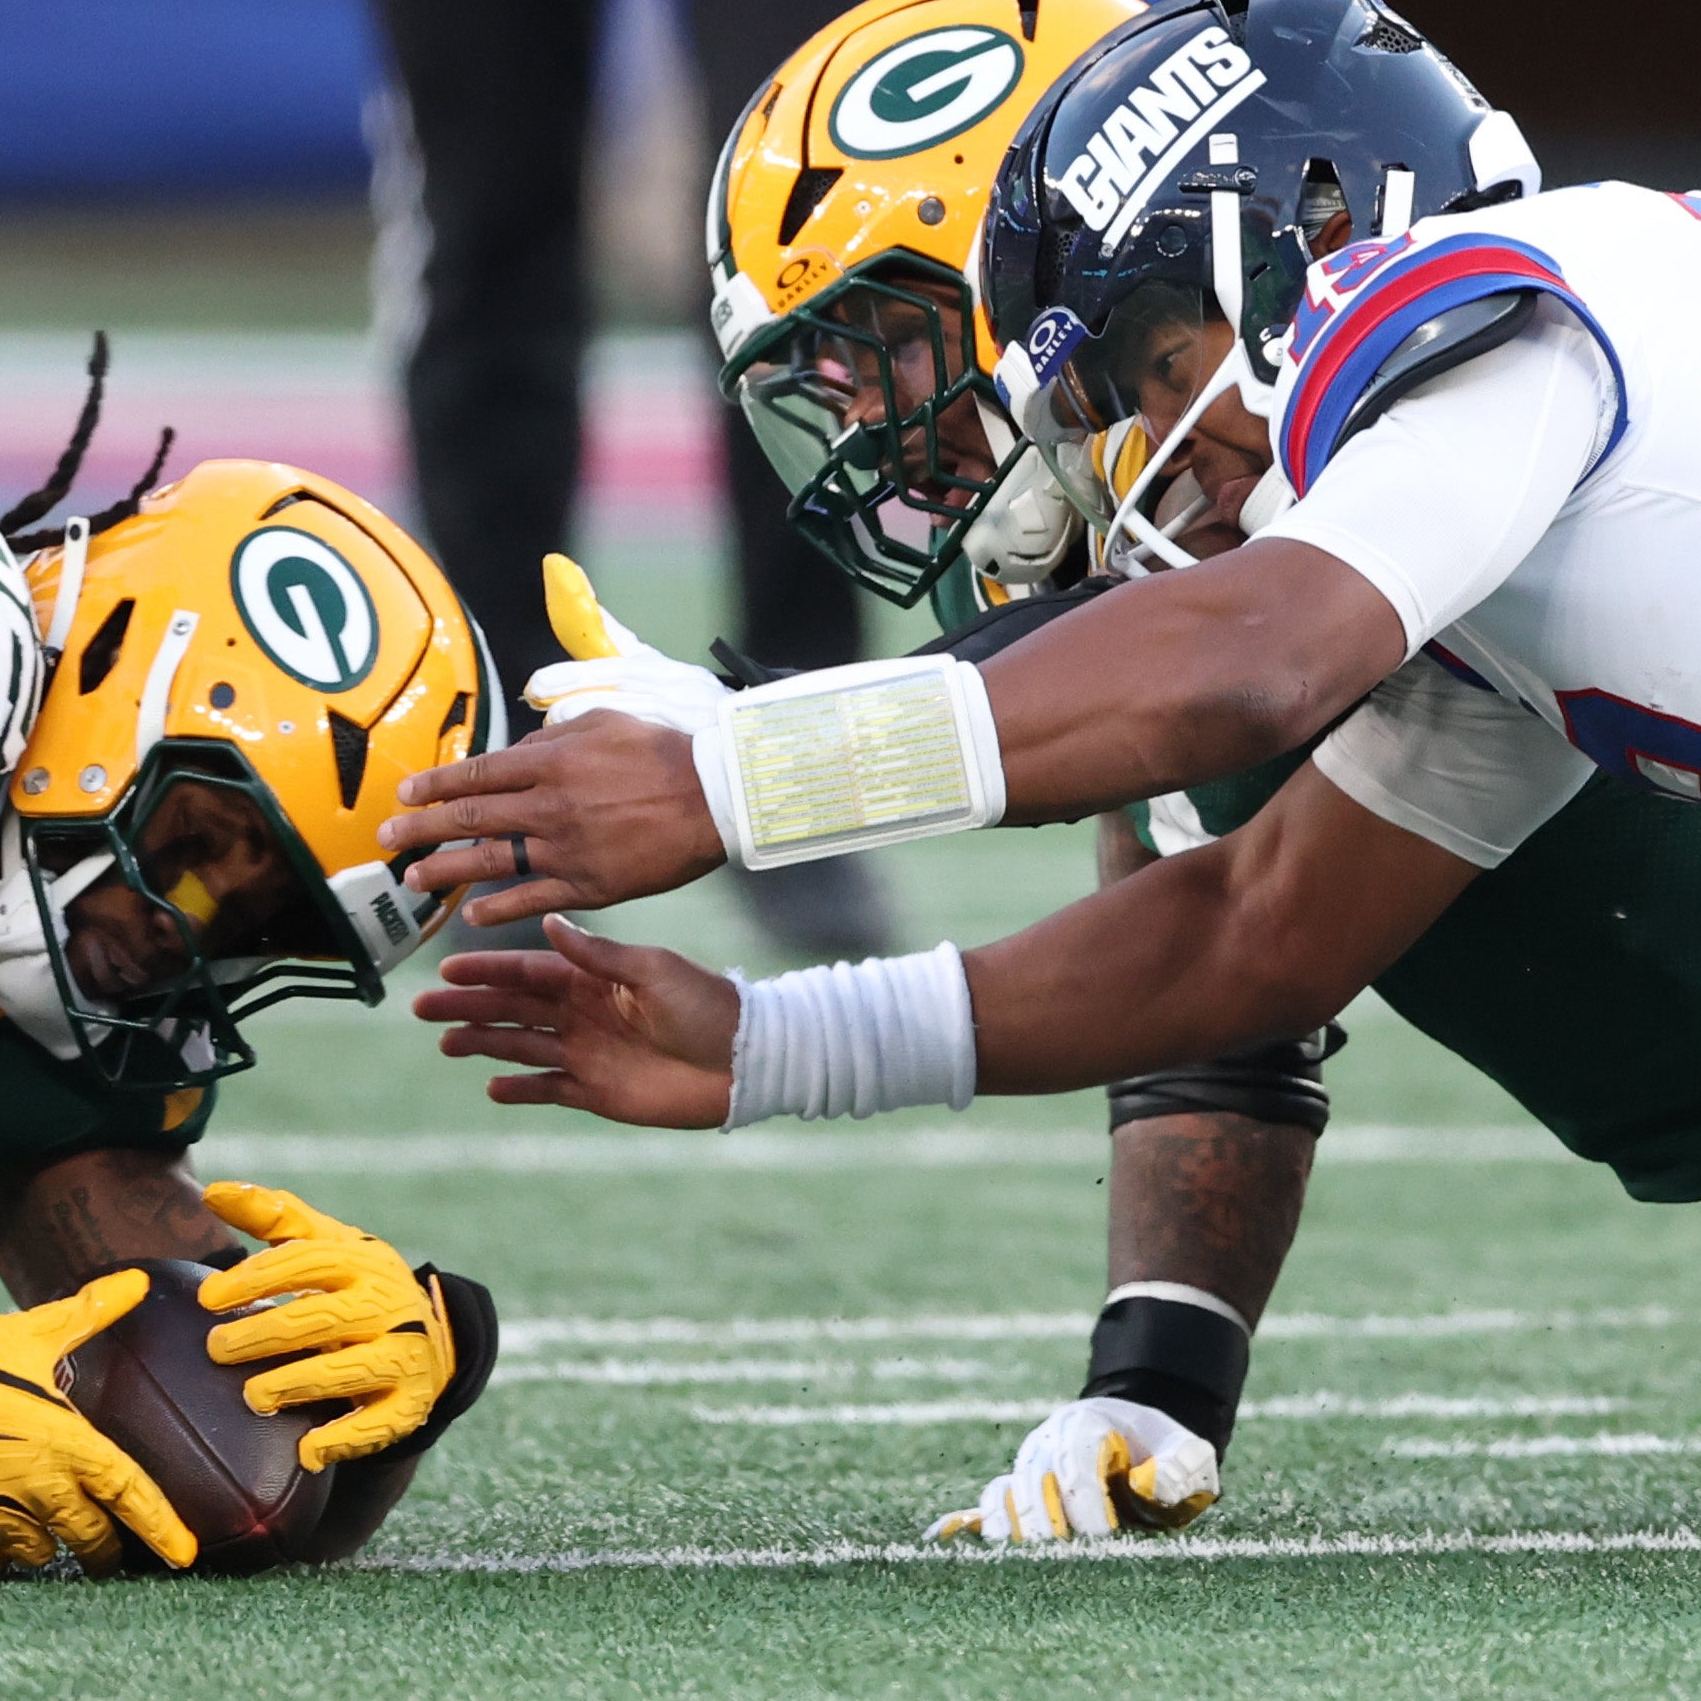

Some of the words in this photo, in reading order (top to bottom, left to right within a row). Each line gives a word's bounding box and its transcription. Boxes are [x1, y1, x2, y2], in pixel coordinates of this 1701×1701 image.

[835, 29, 1017, 152] G
[1060, 26, 1252, 231] GIANTS
[778, 262, 827, 308] OAKLEY
[1035, 321, 1073, 374] OAKLEY
[237, 530, 368, 685] G
